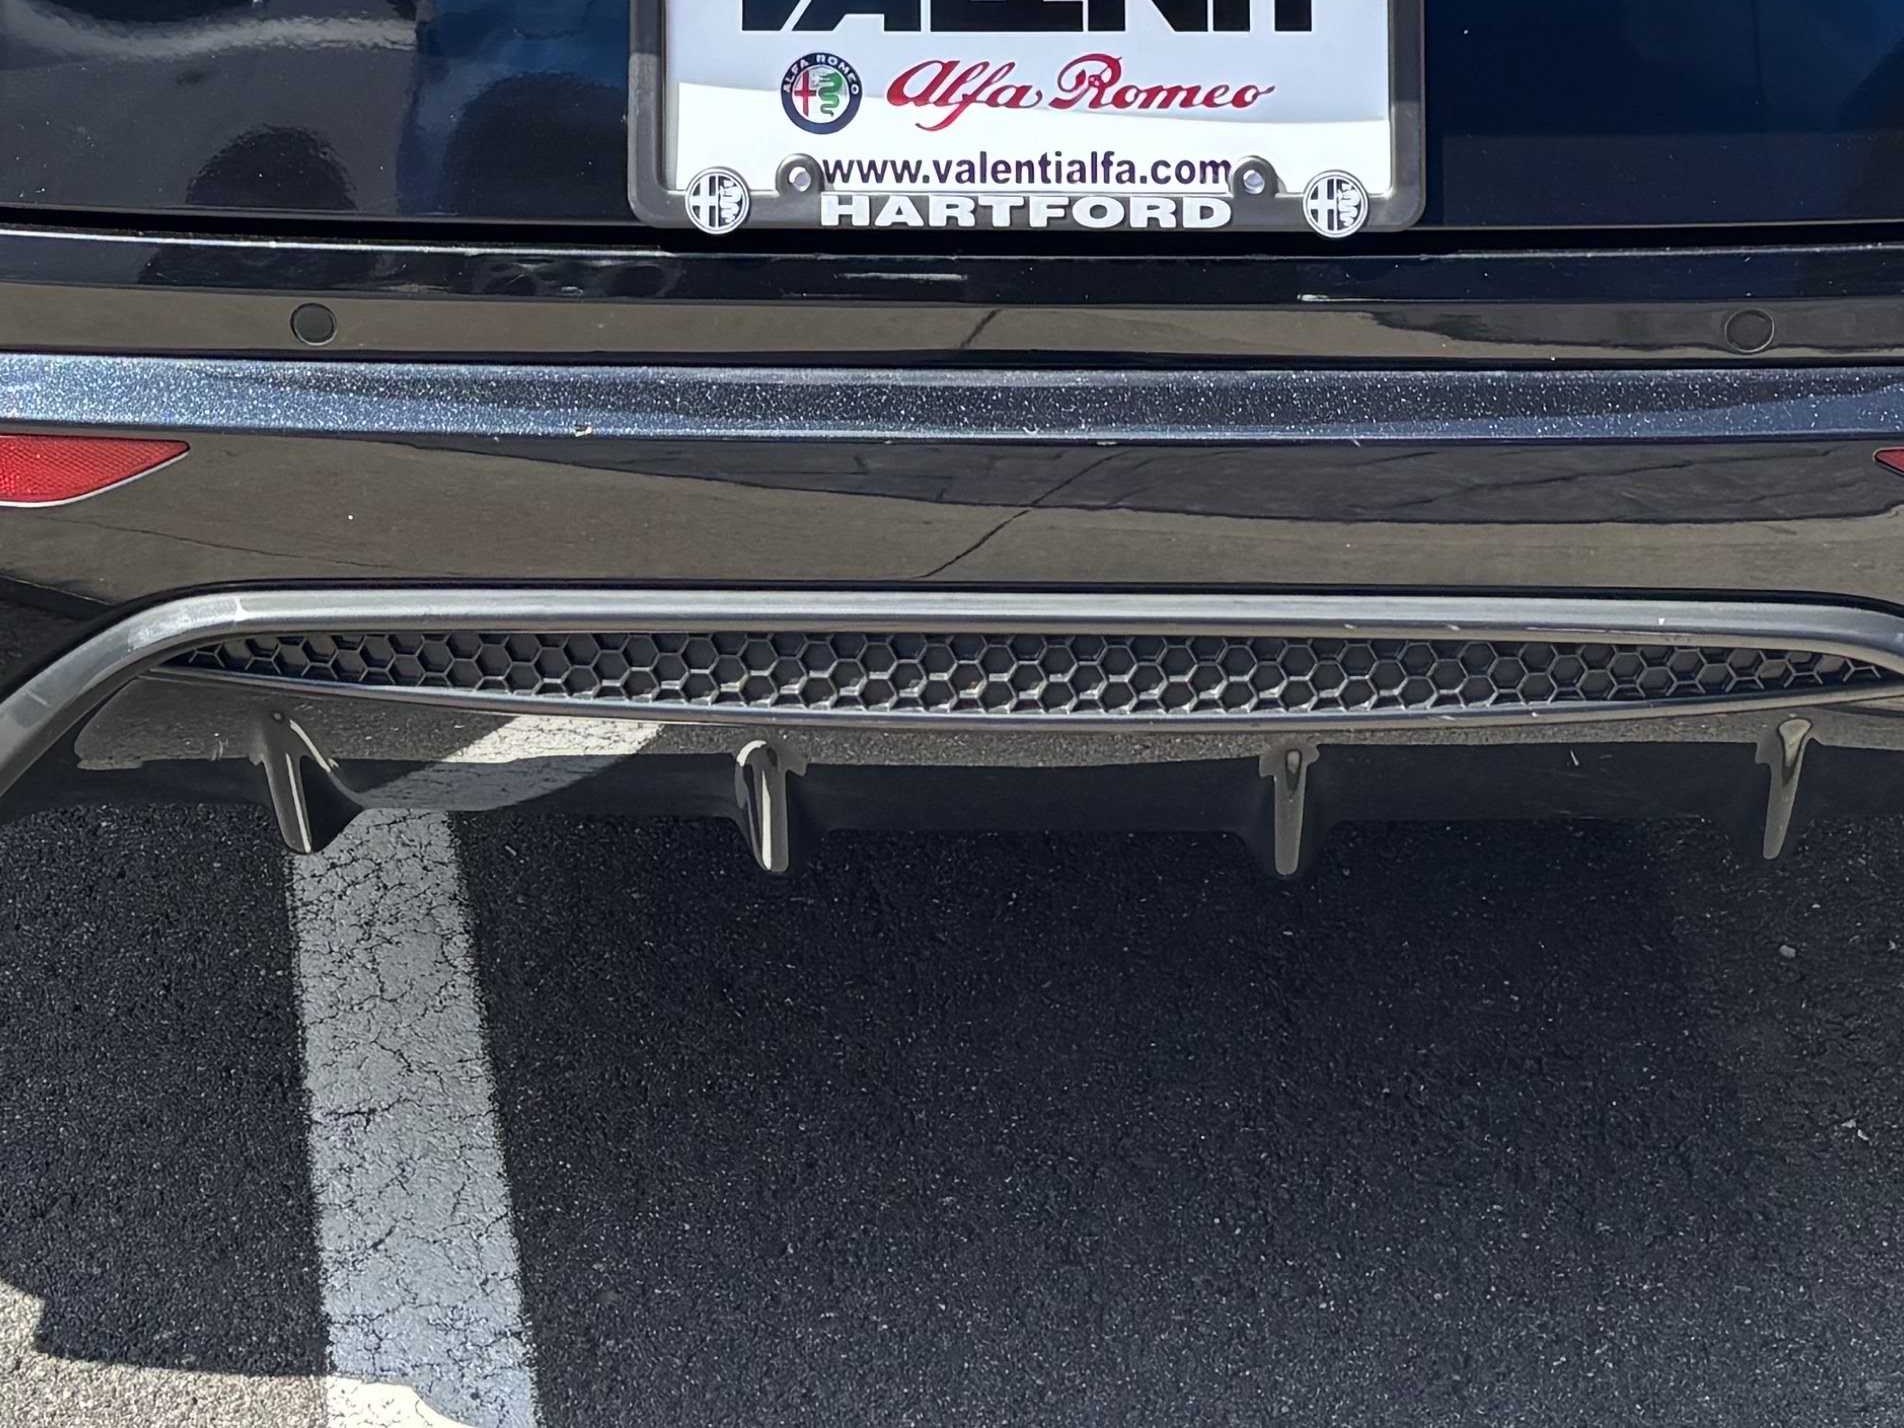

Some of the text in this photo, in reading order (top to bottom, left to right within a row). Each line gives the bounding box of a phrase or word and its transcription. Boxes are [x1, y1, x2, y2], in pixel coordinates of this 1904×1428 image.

[783, 59, 809, 93] ALFA
[886, 52, 1276, 132] Alfa Romeo
[822, 151, 1233, 185] www.valentialfa.com
[820, 194, 1233, 229] HARTFORD
